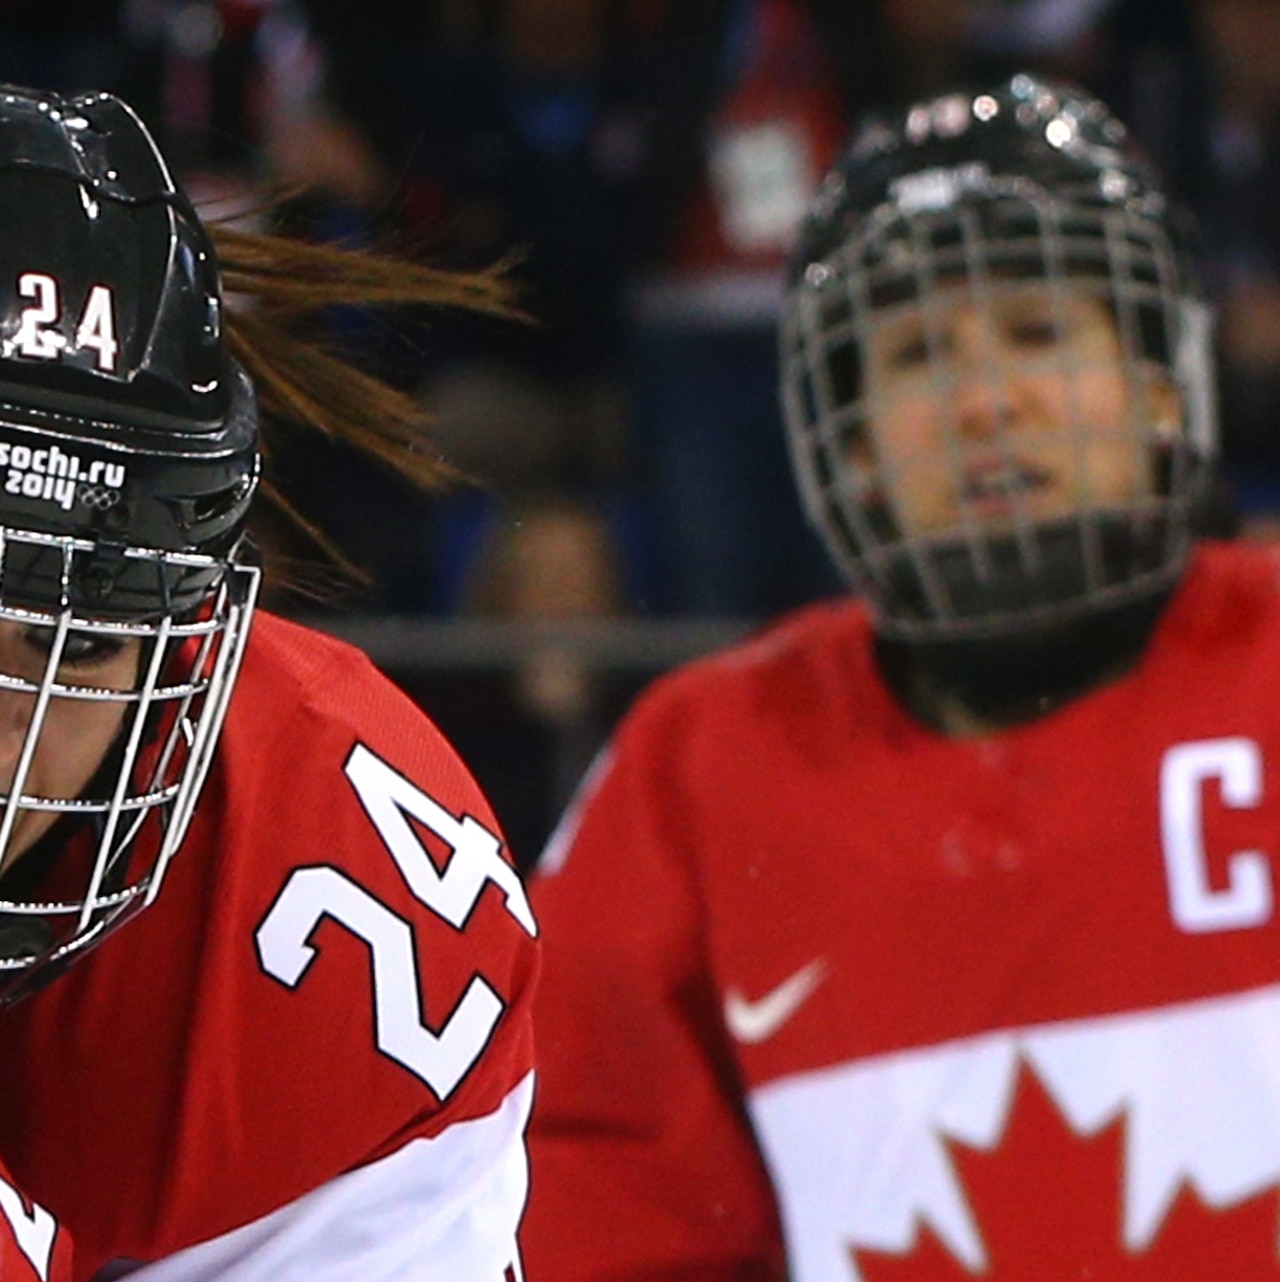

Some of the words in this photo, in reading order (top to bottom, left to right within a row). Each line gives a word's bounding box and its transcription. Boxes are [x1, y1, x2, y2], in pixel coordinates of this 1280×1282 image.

[17, 274, 119, 371] 24
[5, 469, 76, 510] 2014
[1160, 738, 1273, 934] C
[255, 744, 538, 1101] 24
